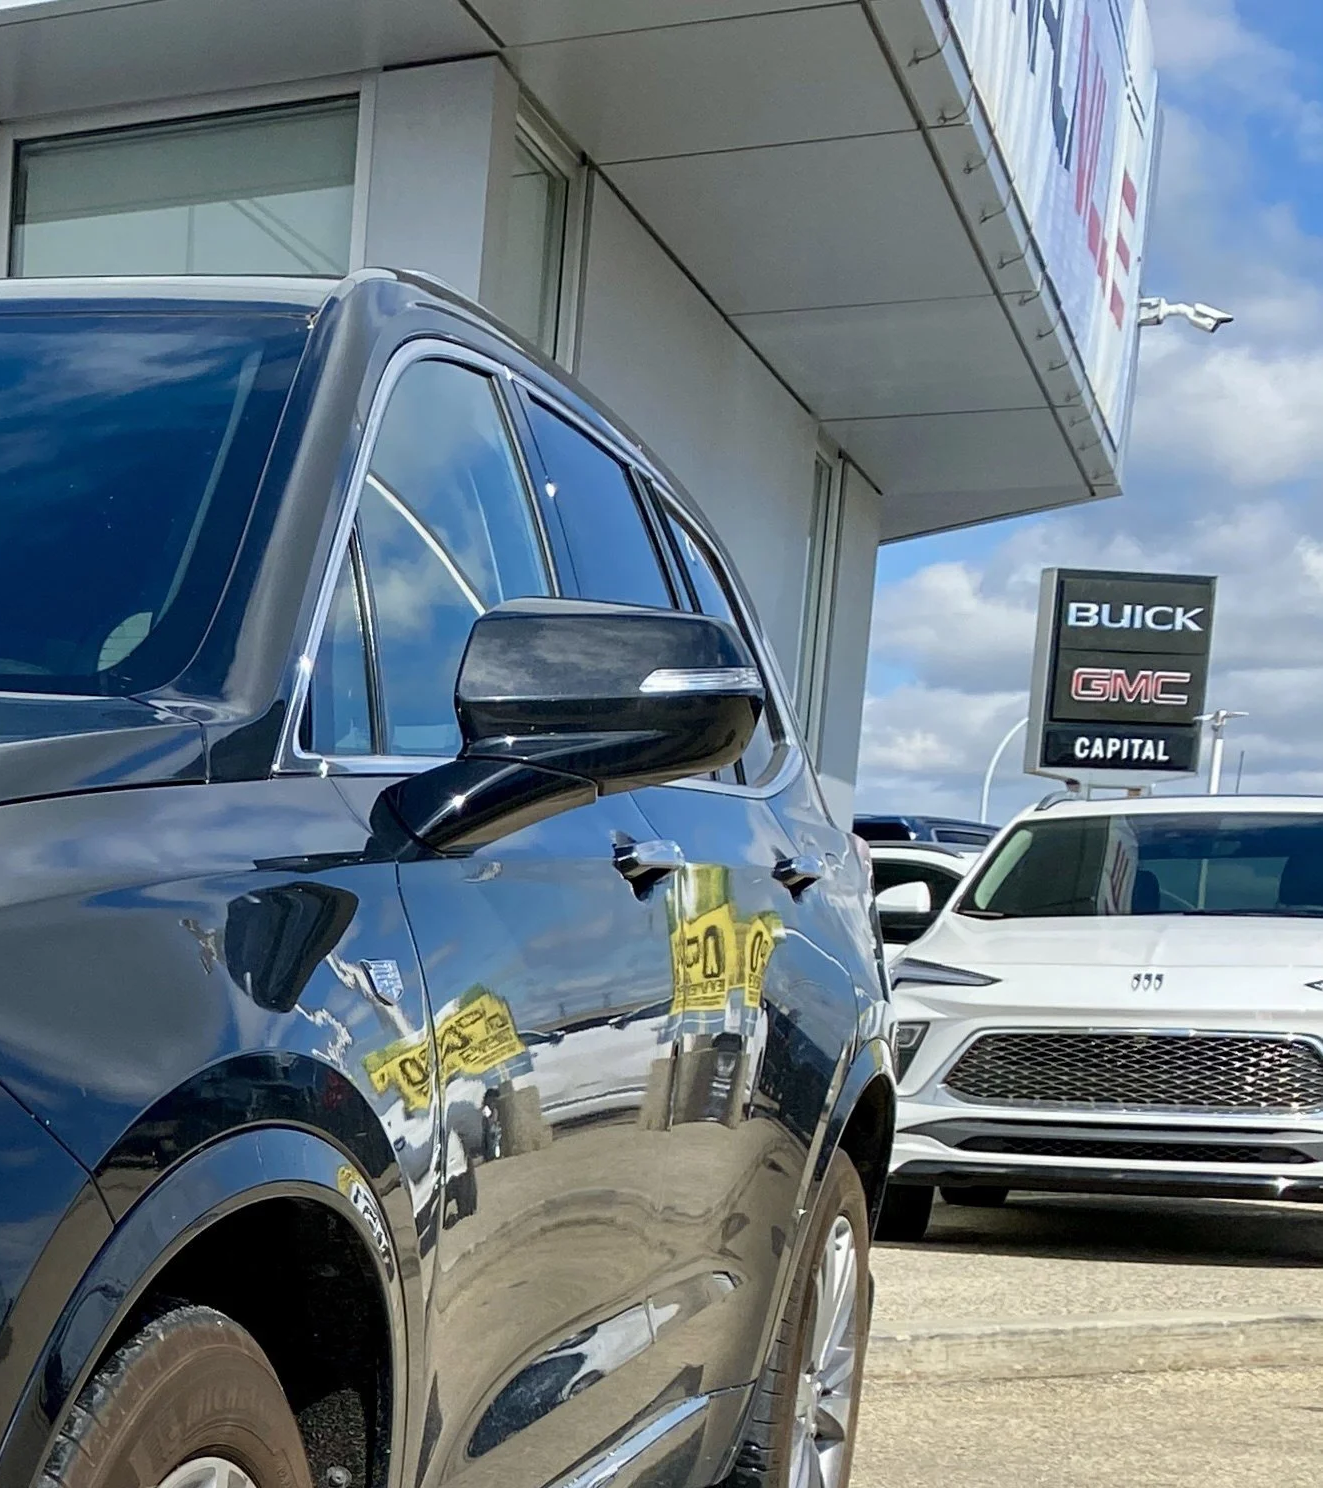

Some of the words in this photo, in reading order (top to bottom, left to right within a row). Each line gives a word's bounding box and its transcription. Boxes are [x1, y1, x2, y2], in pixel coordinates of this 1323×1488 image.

[1067, 602, 1204, 632] BUICK
[1070, 666, 1192, 706] GMC
[1073, 736, 1170, 762] CAPITAL
